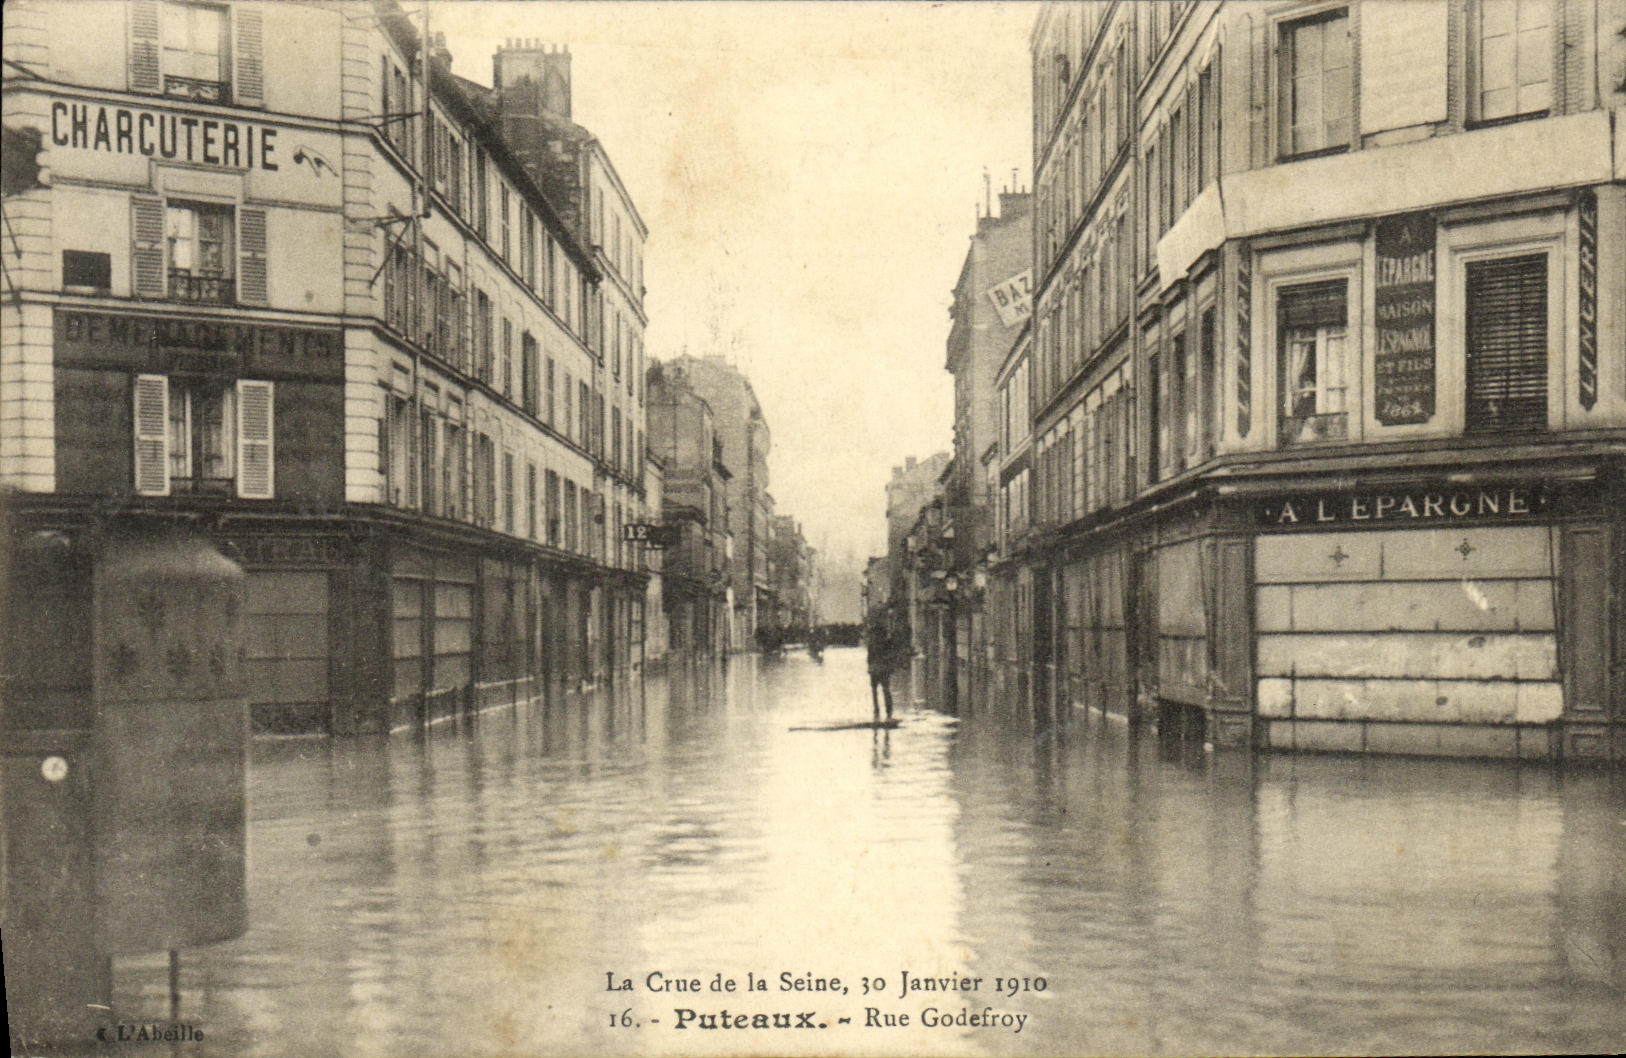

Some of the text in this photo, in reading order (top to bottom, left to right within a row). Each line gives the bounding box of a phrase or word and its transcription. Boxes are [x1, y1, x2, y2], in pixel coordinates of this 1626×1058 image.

[52, 102, 278, 171] CHARCUTERIE
[1377, 299, 1433, 320] MAISON
[1398, 357, 1433, 373] FILS
[1278, 501, 1298, 523] A
[627, 526, 647, 539] 12
